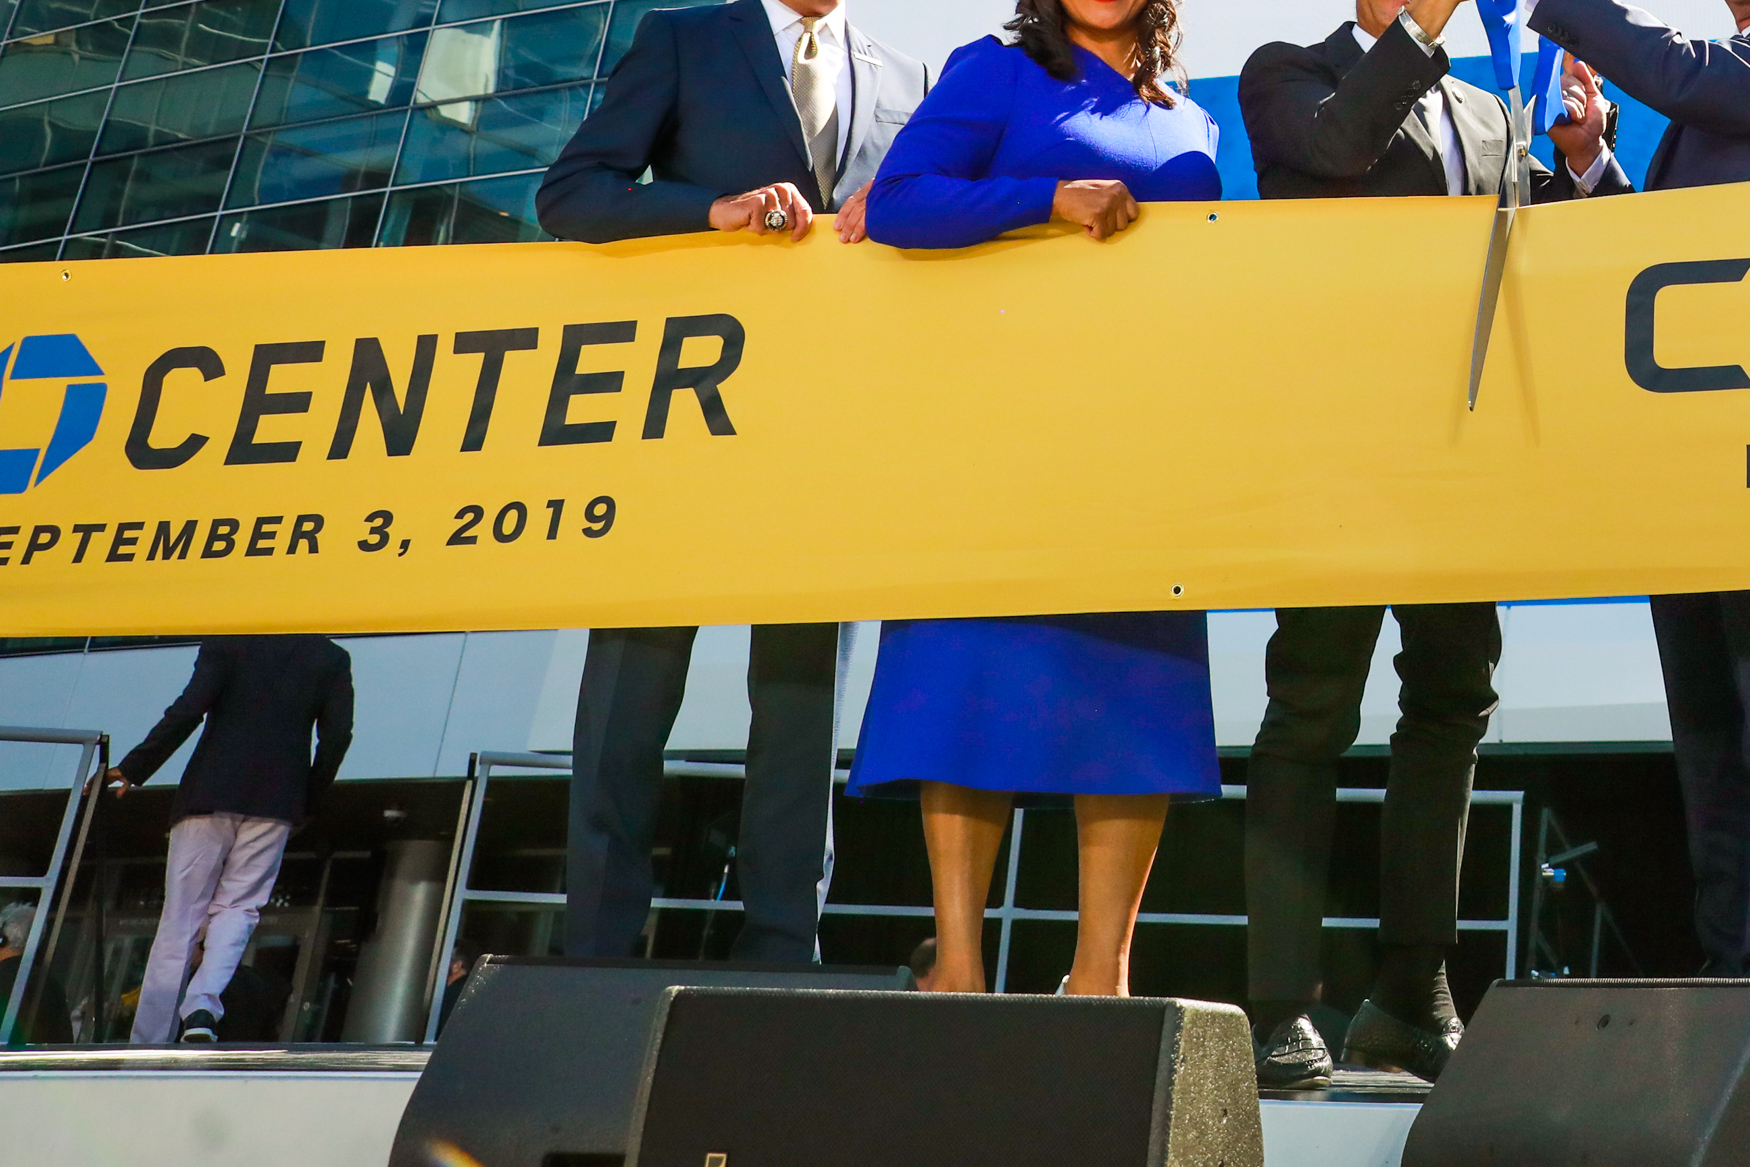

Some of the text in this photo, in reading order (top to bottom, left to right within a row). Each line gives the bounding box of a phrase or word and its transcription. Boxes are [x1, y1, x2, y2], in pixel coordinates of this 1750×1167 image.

[124, 313, 746, 471] CENTER
[0, 495, 618, 567] EPTEMBER 3, 2019
